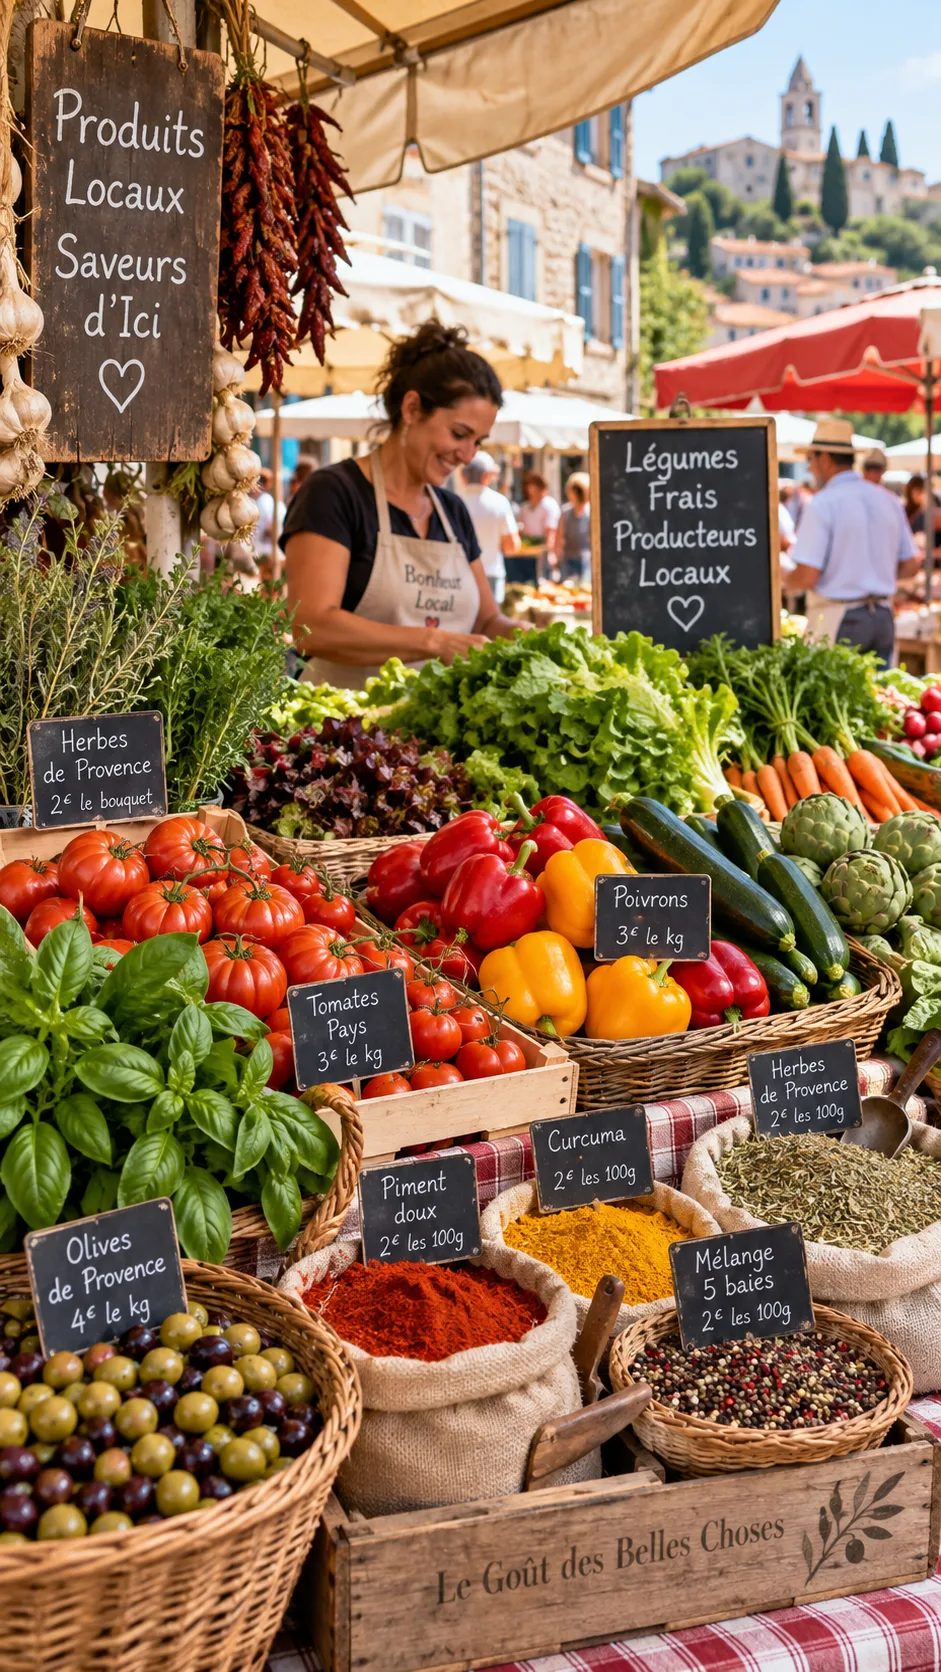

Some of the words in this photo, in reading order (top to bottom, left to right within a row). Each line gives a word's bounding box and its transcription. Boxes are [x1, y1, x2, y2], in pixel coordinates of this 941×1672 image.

[54, 88, 204, 158] Produits
[66, 159, 184, 214] Locaux
[56, 233, 186, 284] Saveurs
[84, 294, 160, 339] d'Ici
[626, 441, 738, 480] Légumes
[648, 481, 717, 510] Frais
[614, 520, 756, 551] Producteurs
[639, 558, 730, 587] Locaux
[414, 590, 454, 612] Local
[62, 728, 127, 753] Herbes
[44, 762, 65, 783] de
[75, 758, 151, 780] Provence
[51, 794, 71, 814] 2€
[81, 793, 92, 810] le
[101, 788, 152, 814] bouquet
[614, 885, 687, 908] Poivrons
[616, 926, 638, 944] 3€
[647, 927, 658, 944] le
[666, 927, 683, 953] kg
[306, 989, 378, 1016] Tomates
[327, 1018, 366, 1044] Pays
[318, 1050, 337, 1072] 3€
[346, 1048, 358, 1066] le
[365, 1044, 382, 1069] kg
[772, 1056, 825, 1079] Herbes
[760, 1085, 778, 1104] de
[785, 1080, 848, 1099] Provence
[771, 1109, 787, 1127] 2€
[795, 1108, 810, 1123] les
[816, 1103, 844, 1123] 100g
[548, 1130, 626, 1152] Curcuma
[381, 1170, 446, 1199] Piment
[554, 1170, 573, 1190] 2€
[582, 1168, 599, 1185] les
[606, 1164, 635, 1185] 100g
[395, 1202, 436, 1224] doux
[67, 1233, 131, 1264] Olives
[380, 1234, 399, 1257] 2€
[408, 1234, 426, 1251] les
[432, 1228, 463, 1251] 100g
[696, 1246, 774, 1273] Mélange
[49, 1277, 73, 1304] de
[82, 1257, 166, 1294] Provence
[704, 1278, 716, 1300] 5
[726, 1272, 774, 1296] baies
[71, 1306, 95, 1333] 4€
[106, 1302, 121, 1324] le
[129, 1294, 150, 1323] kg
[702, 1309, 722, 1332] 2€
[732, 1307, 750, 1326] les
[757, 1301, 791, 1325] 100g
[436, 1571, 471, 1606] Le
[482, 1556, 550, 1594] Goût
[562, 1546, 603, 1580] des
[616, 1529, 690, 1569] Belles
[701, 1518, 784, 1552] Choses
